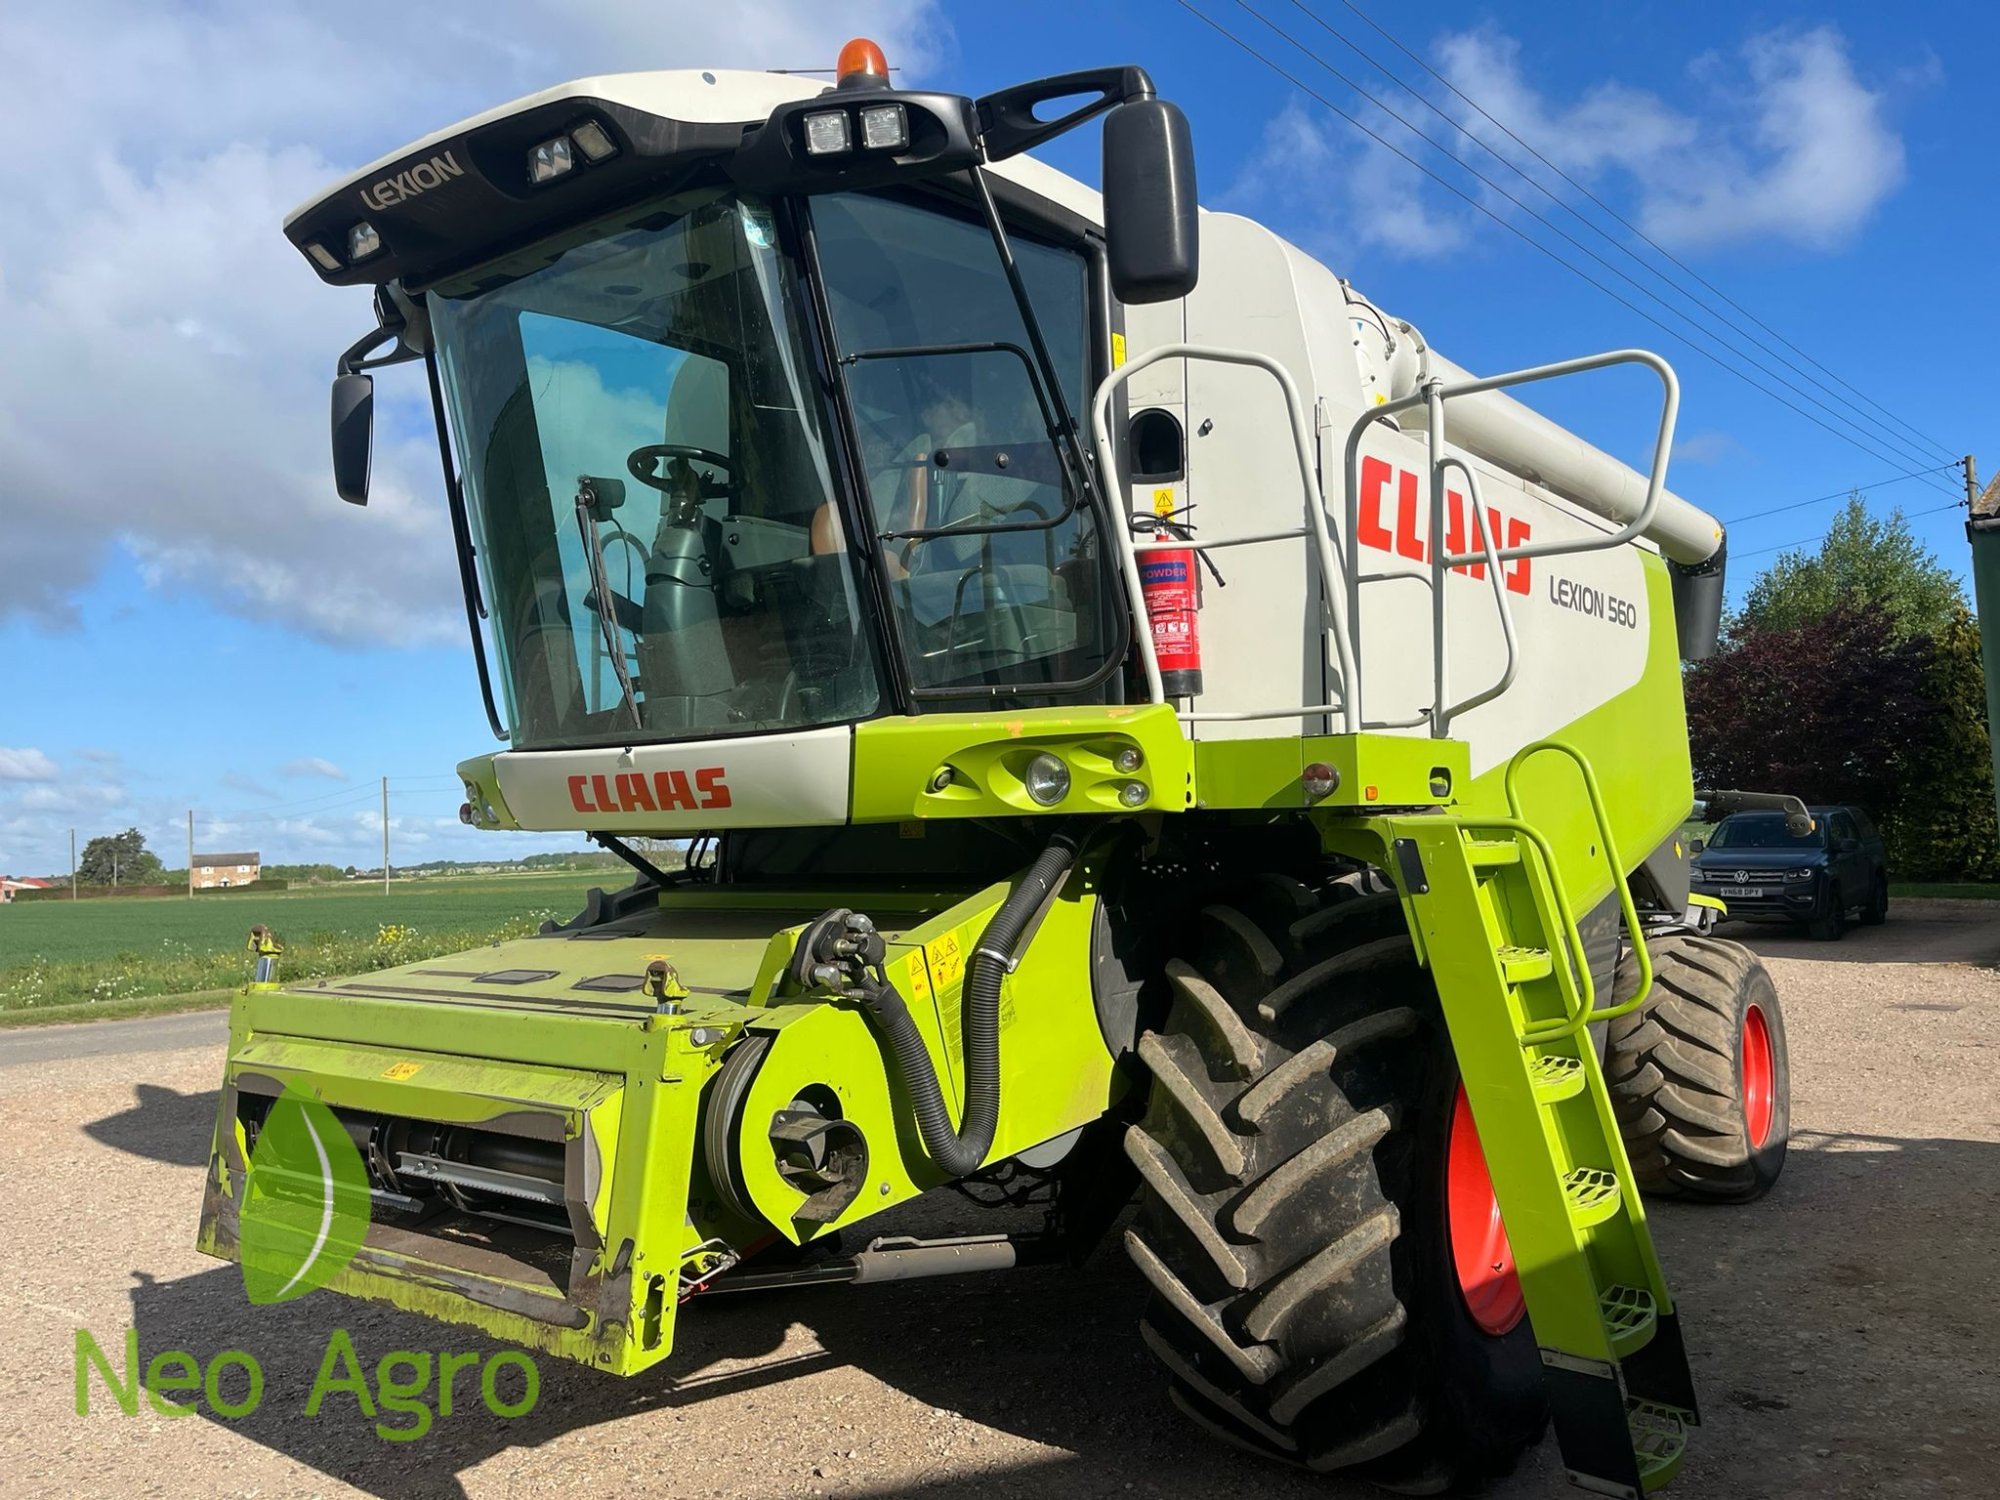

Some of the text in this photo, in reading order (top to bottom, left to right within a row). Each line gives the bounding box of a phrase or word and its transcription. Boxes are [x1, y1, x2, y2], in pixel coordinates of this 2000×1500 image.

[360, 150, 465, 211] LEXION
[1357, 454, 1531, 597] CLAAS
[1549, 574, 1637, 630] LEXION 560
[567, 767, 732, 813] CLAAS
